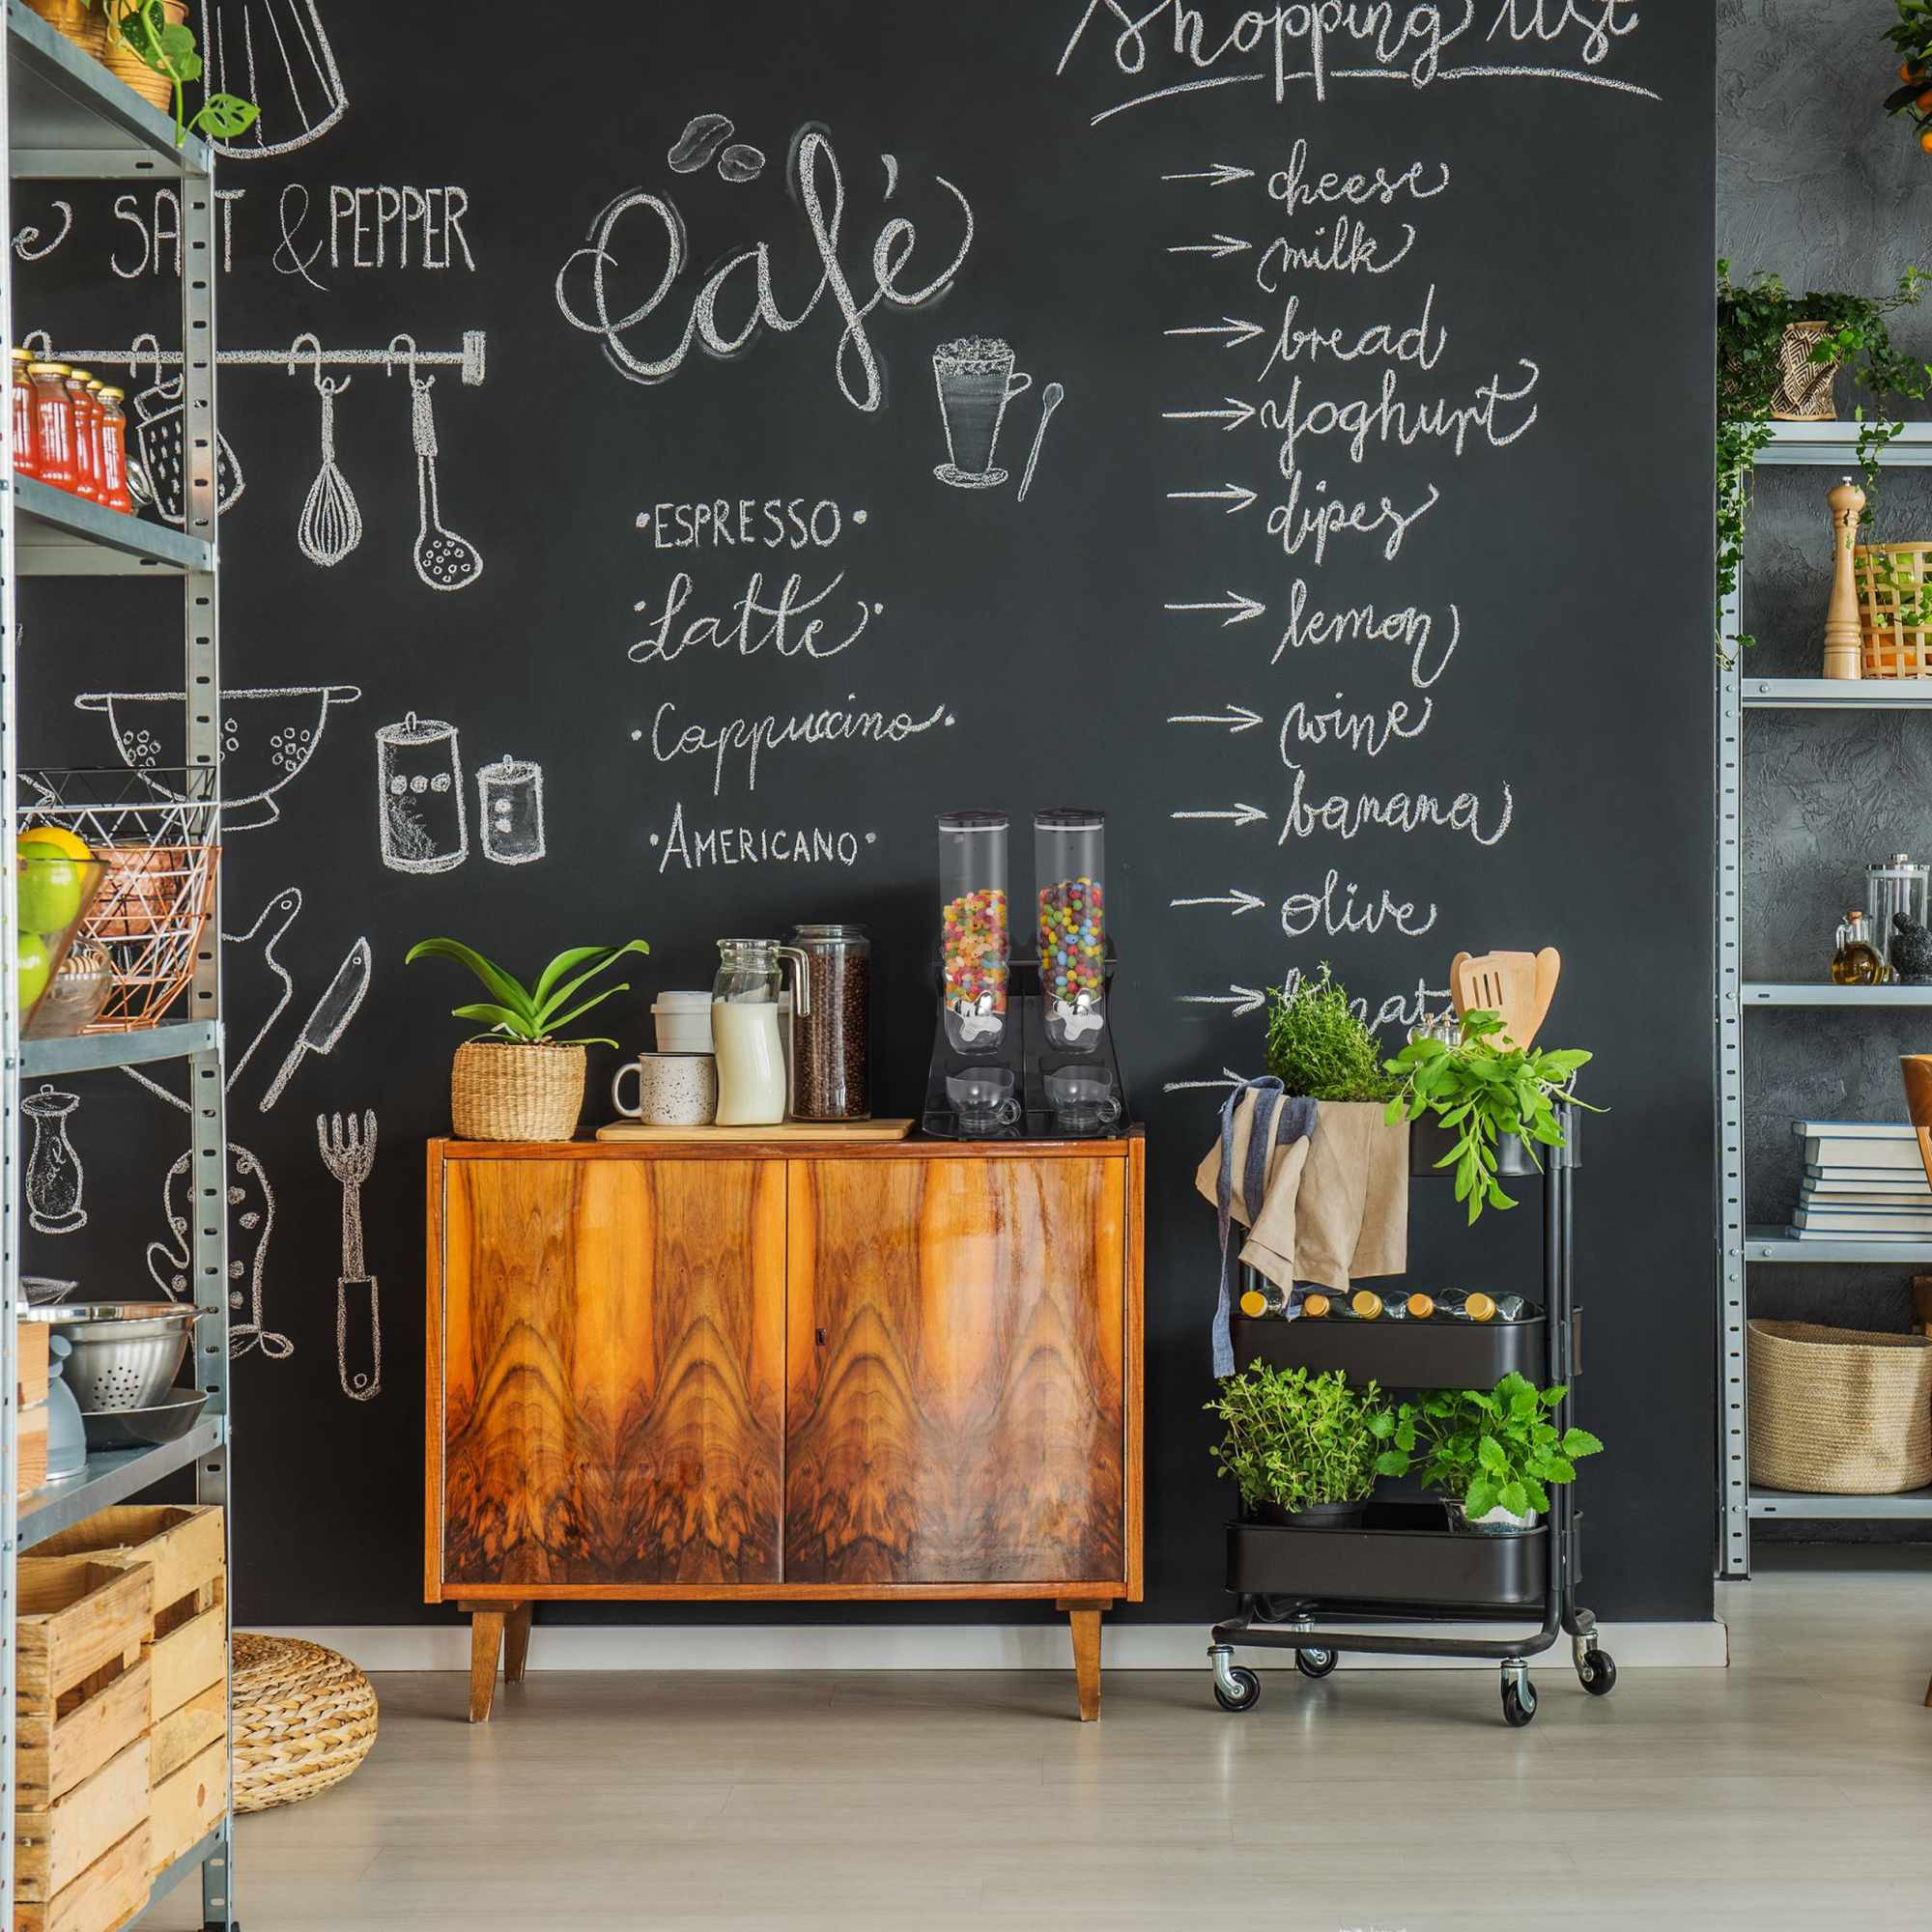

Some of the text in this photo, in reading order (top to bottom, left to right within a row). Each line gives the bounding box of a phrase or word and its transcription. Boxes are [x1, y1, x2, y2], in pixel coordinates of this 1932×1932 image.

[1267, 138, 1450, 215] cheese
[110, 187, 246, 278] SAT
[272, 183, 329, 292] &
[329, 185, 475, 272] PEPPER
[1257, 214, 1416, 293] milk
[1258, 283, 1448, 383] bread
[654, 497, 842, 550] ESPRESSO
[627, 570, 869, 664] Latte
[1270, 578, 1461, 689] lemon
[1279, 691, 1434, 769] wine
[1277, 769, 1514, 846] banana
[1280, 868, 1438, 938] olive
